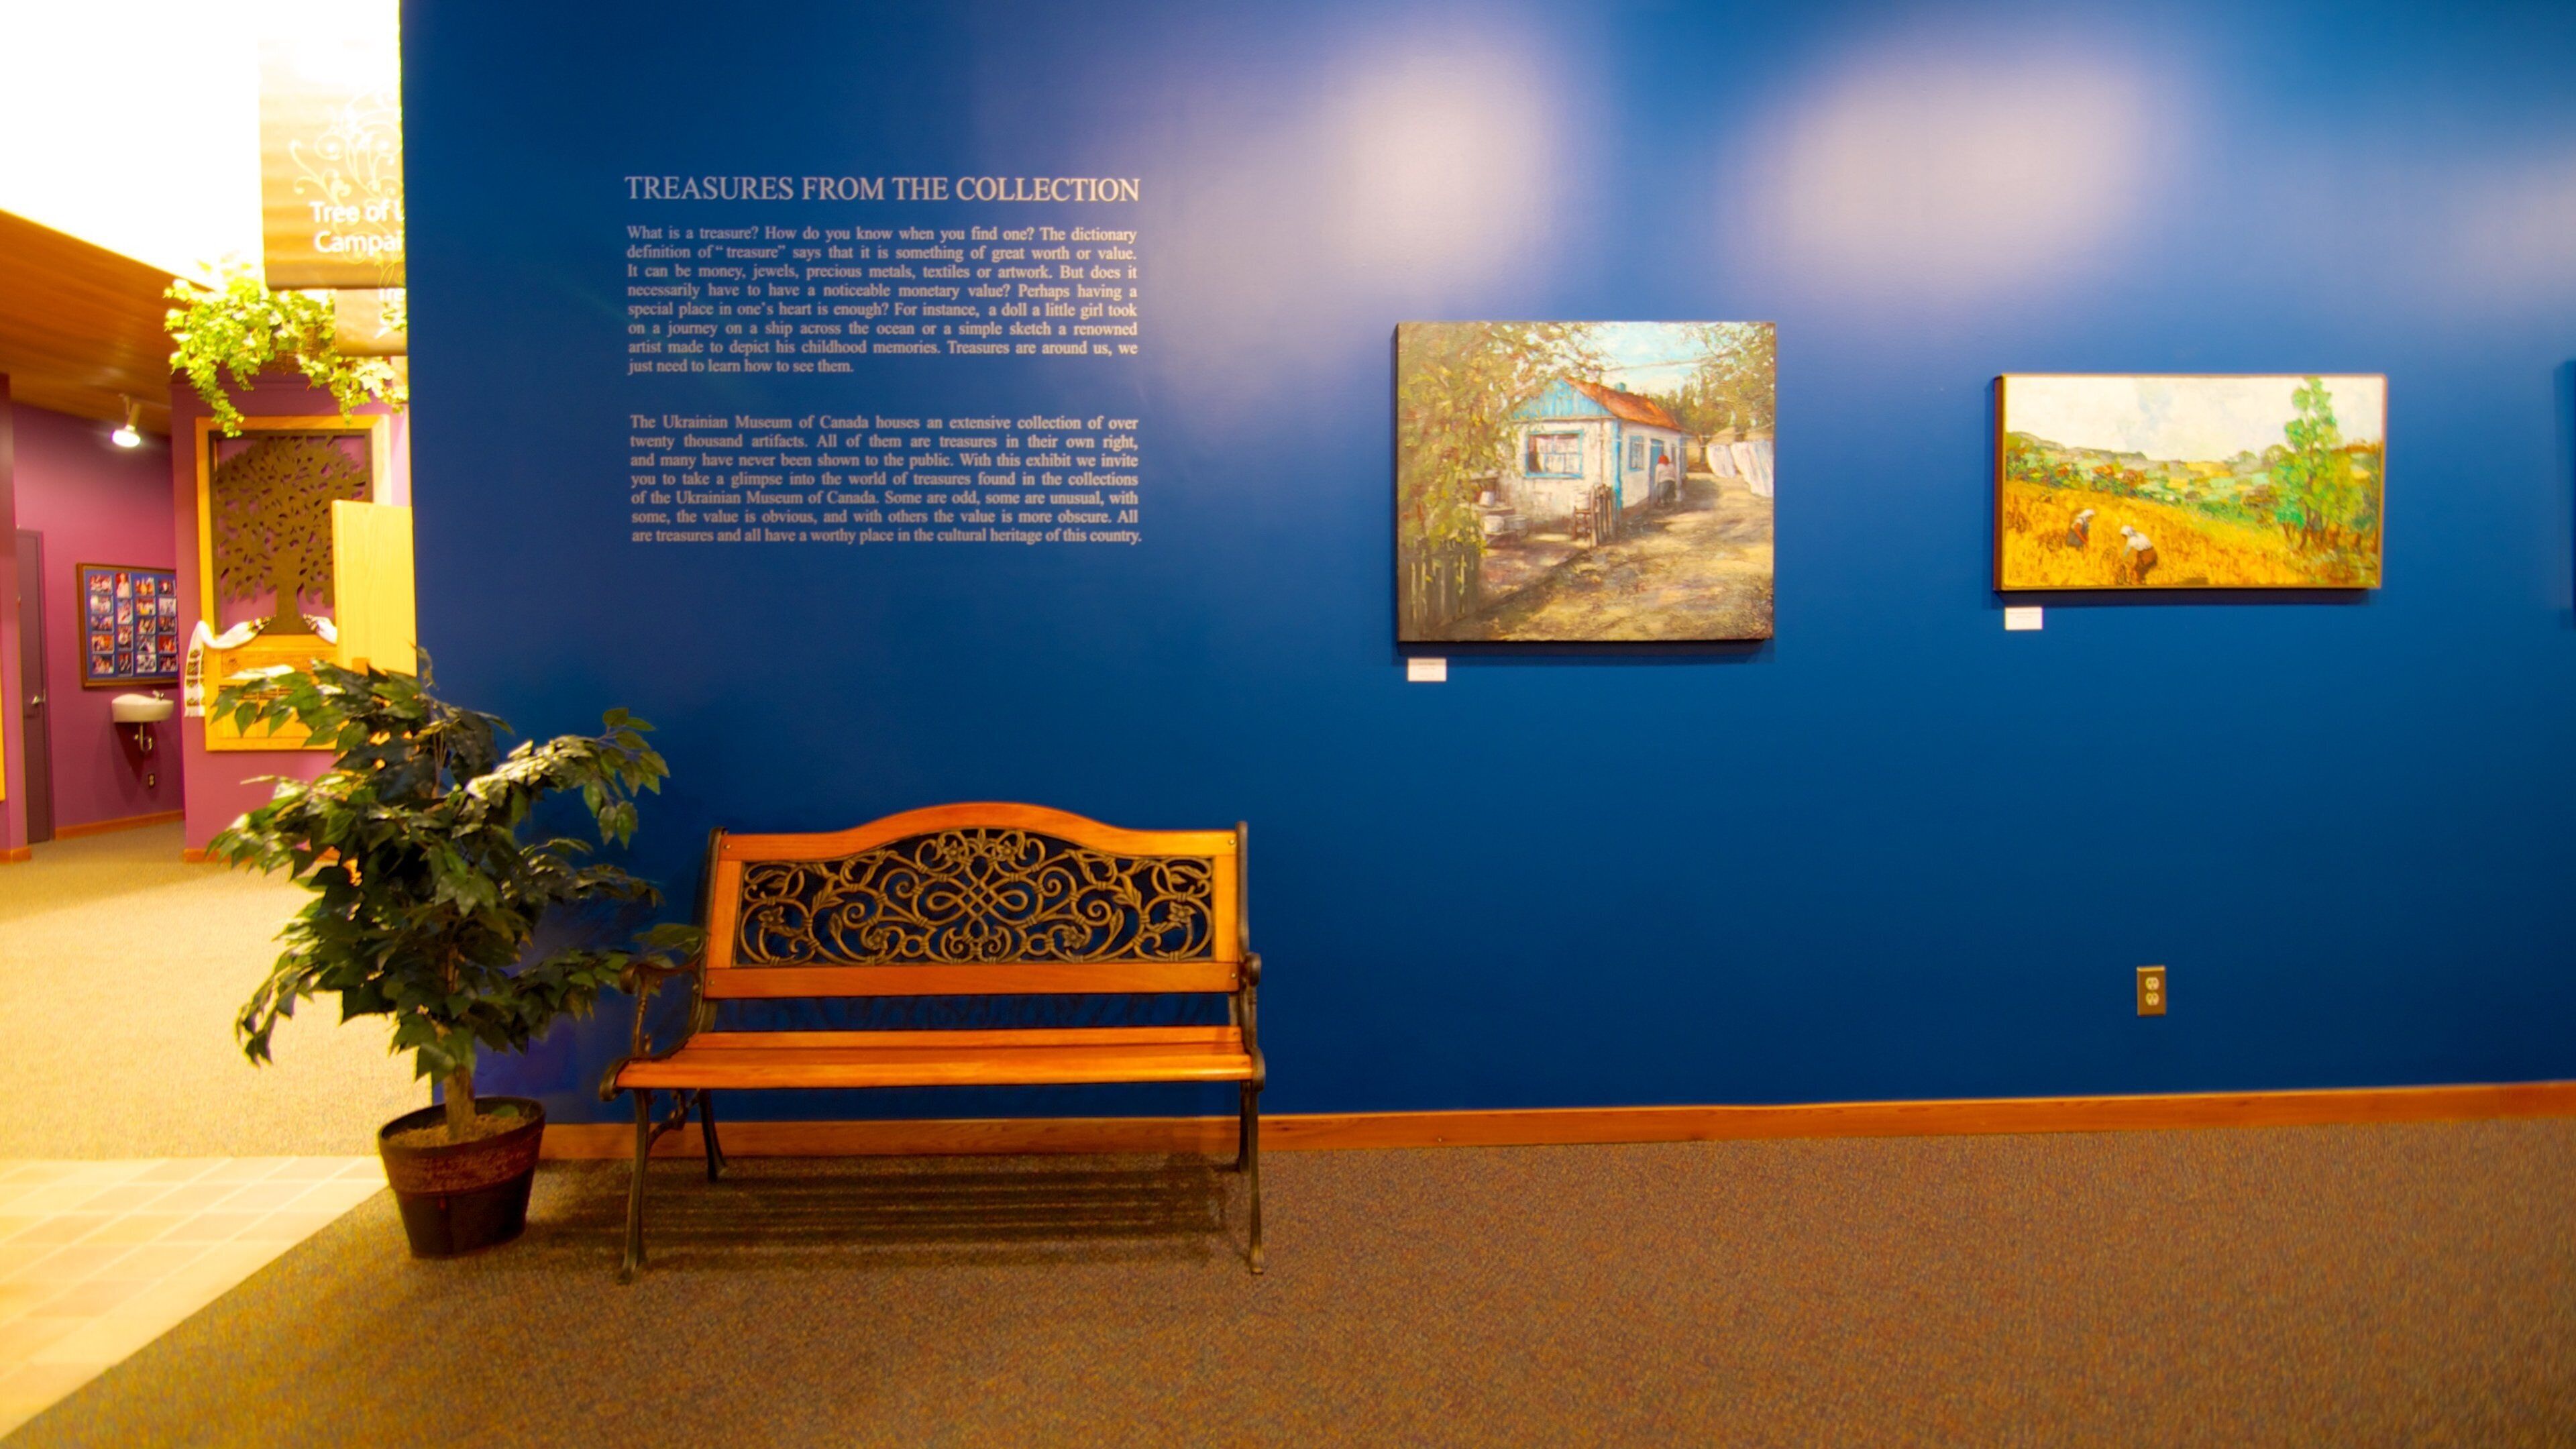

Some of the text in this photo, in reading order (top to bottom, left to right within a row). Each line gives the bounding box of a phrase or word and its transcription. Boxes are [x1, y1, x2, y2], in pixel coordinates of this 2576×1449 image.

[623, 176, 1141, 202] TREASURES FROM THE COLLECTION
[309, 201, 360, 223] Tree
[366, 199, 390, 222] of
[626, 225, 1138, 245] What is a treasure? How do you know when you find one? The dictionary
[627, 263, 1138, 281] It can be money, jewels, precious metals, textiles or artwork. But does it
[627, 282, 1138, 301] necessarily have to have a noticeable monetary value? Perhaps having a
[628, 339, 1138, 357] artist made to depict his childhood memories. Treasures are around us, we
[629, 414, 1140, 430] The Ukrainian Museum of Canada houses an extensive collection of over
[629, 433, 1138, 452] twenty thousand artifacts. All of them are treasures in their own right,
[630, 452, 1139, 470] and many have never been shown to the public. With this exhibit we invite
[630, 471, 1139, 489] you to take a glimpse into the world of treasures found in the collections
[630, 490, 1139, 506] of the Ukrainian Museum of Canada. Some are odd, some are unusual, with
[631, 508, 1138, 525] some, the value is obvious, and with others the value is more obscure. All
[631, 527, 1142, 546] are treasures and all have a worthy place in the cultural heritage of this country.
